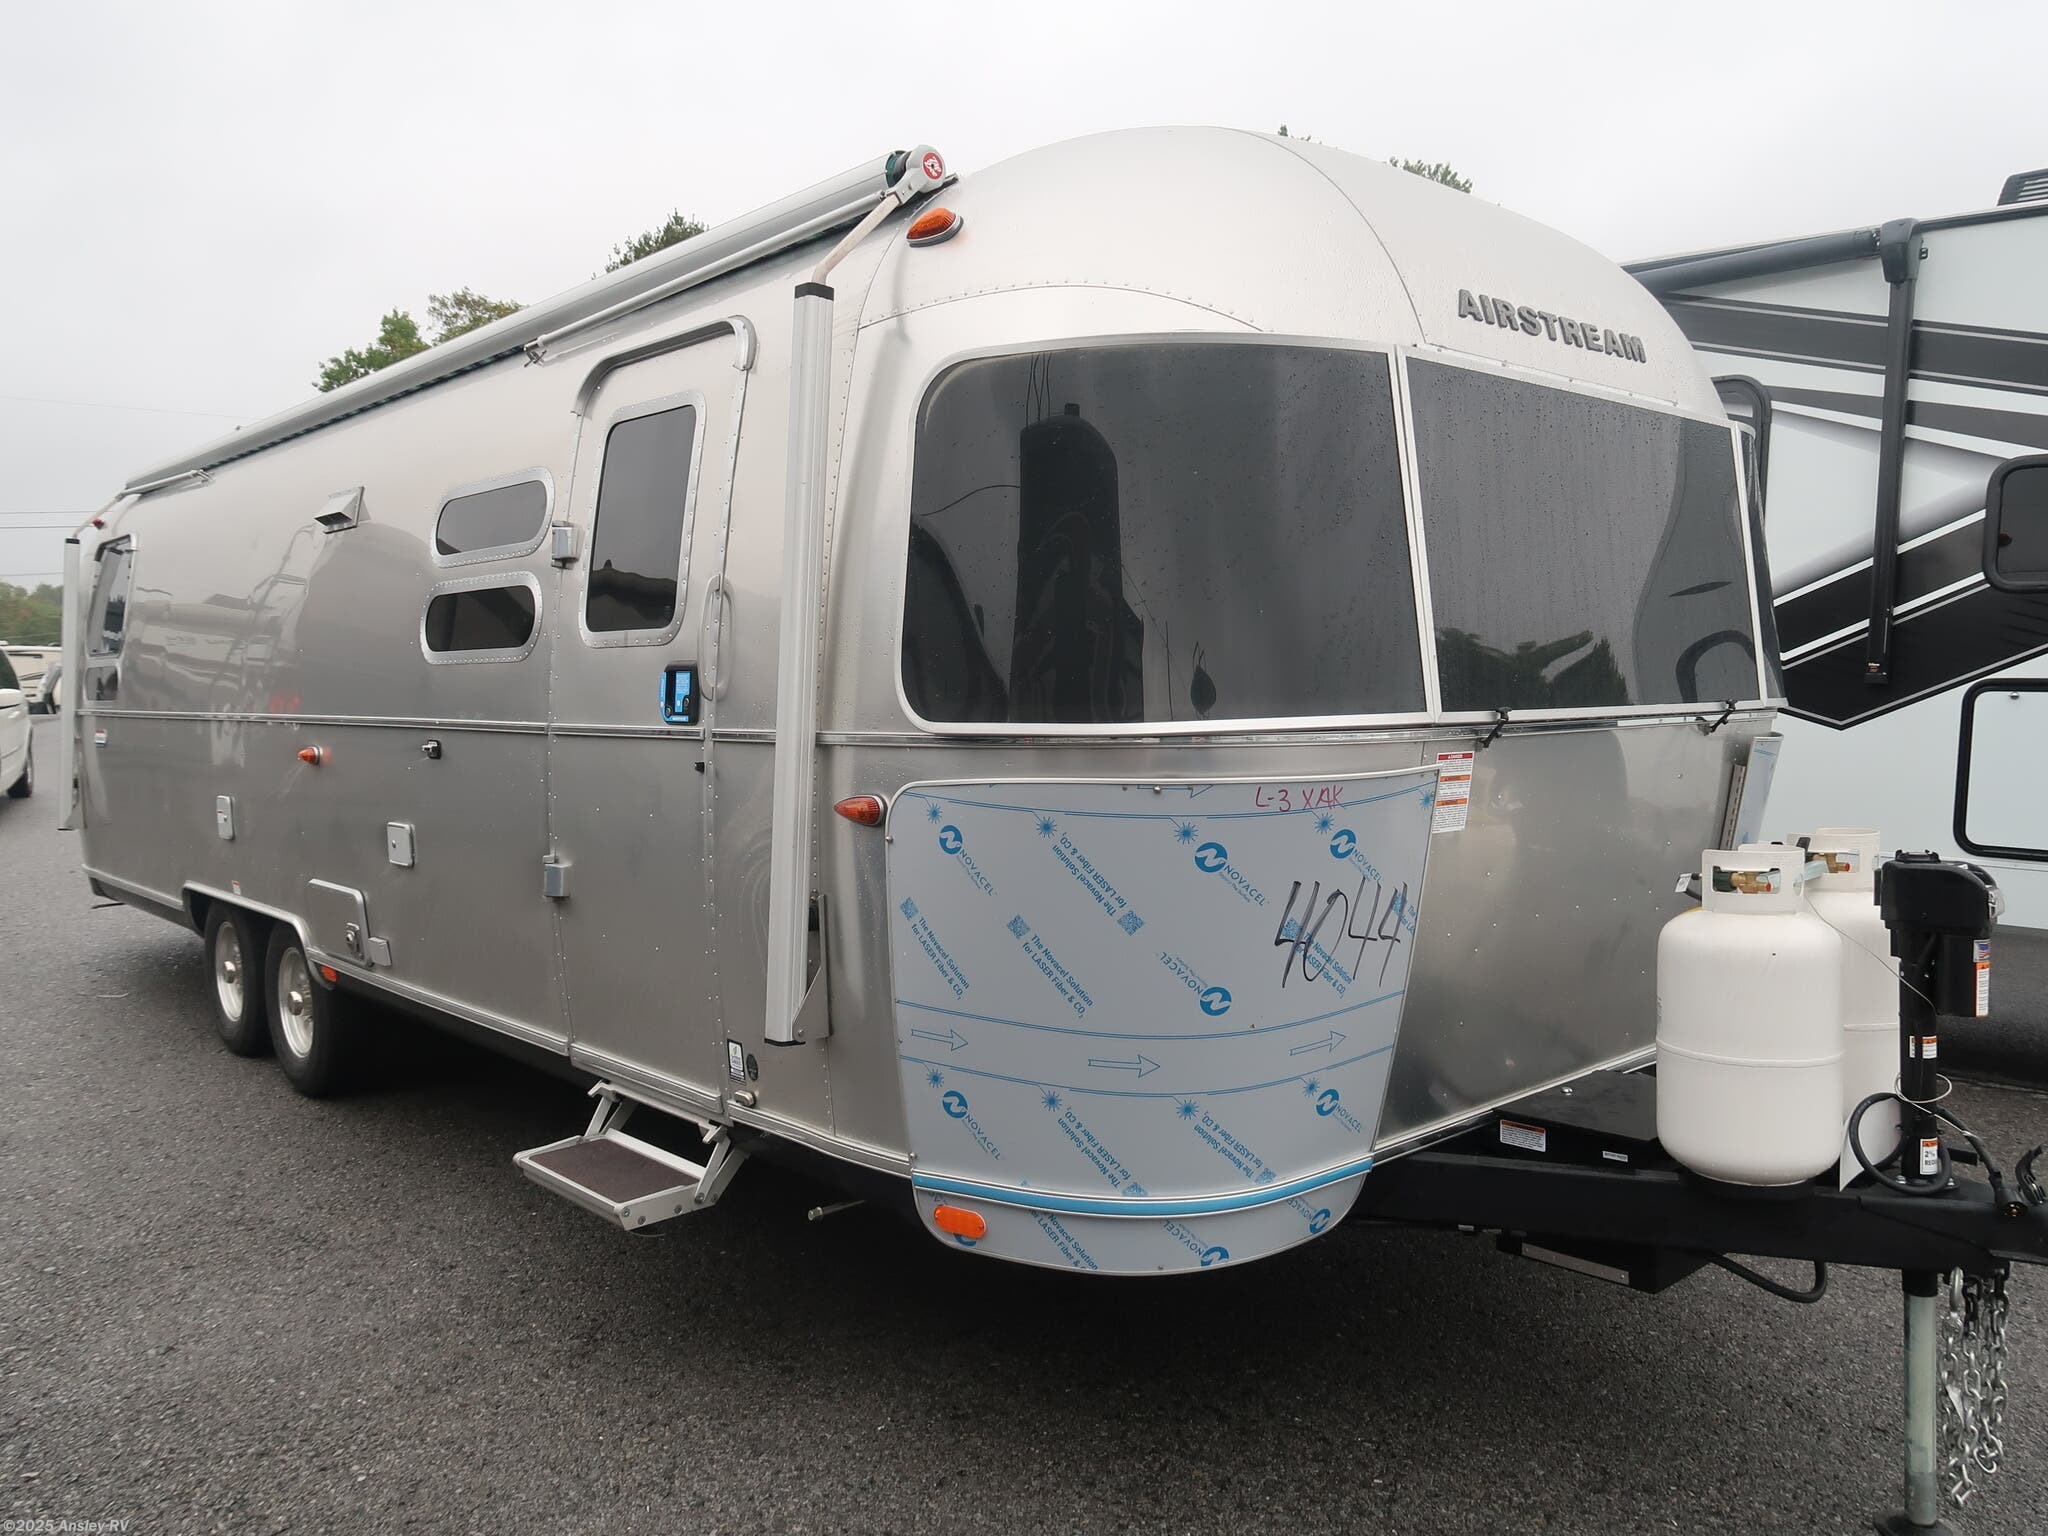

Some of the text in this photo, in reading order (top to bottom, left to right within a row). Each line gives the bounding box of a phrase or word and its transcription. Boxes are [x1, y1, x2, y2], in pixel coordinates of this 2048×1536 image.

[1458, 288, 1647, 364] AIRSTREAM
[959, 849, 994, 896] NOVACEL
[1052, 845, 1117, 916] The Novacel Solution
[1076, 855, 1095, 874] Fiber
[1352, 849, 1381, 884] NOVACEL
[1092, 872, 1117, 898] LASER
[1115, 896, 1127, 908] for
[1223, 864, 1265, 906] NOVACEL
[1275, 876, 1407, 988] 4044
[911, 924, 920, 936] for
[918, 935, 936, 960] LASER
[934, 958, 951, 978] Fiber
[948, 977, 954, 985] &
[919, 917, 969, 989] The Novacel Solution
[1022, 942, 1033, 954] for
[1031, 953, 1054, 979] LASER
[1051, 976, 1069, 996] Fiber
[1067, 995, 1075, 1003] &
[1031, 934, 1093, 1007] The Novacel Solution
[1332, 961, 1355, 984] Solution
[1160, 952, 1204, 995] NOVACEL
[964, 1114, 1000, 1160] NOVACEL
[1075, 1121, 1083, 1129] &
[1081, 1129, 1099, 1148] Fiber
[1212, 1124, 1220, 1132] &
[1218, 1129, 1236, 1146] Fiber
[1334, 1105, 1362, 1133] NOVACEL
[1058, 1118, 1121, 1188] The Novacel Solution
[1097, 1146, 1121, 1170] LASER
[1194, 1124, 1254, 1178] The Novacel Solution
[1233, 1142, 1255, 1161] LASER
[1253, 1158, 1263, 1169] for
[1119, 1169, 1131, 1180] for
[1038, 1218, 1059, 1243] LASER
[1057, 1241, 1074, 1260] Fiber
[1047, 1213, 1098, 1270] Novacel Solution
[1163, 1219, 1204, 1256] NOVACEL
